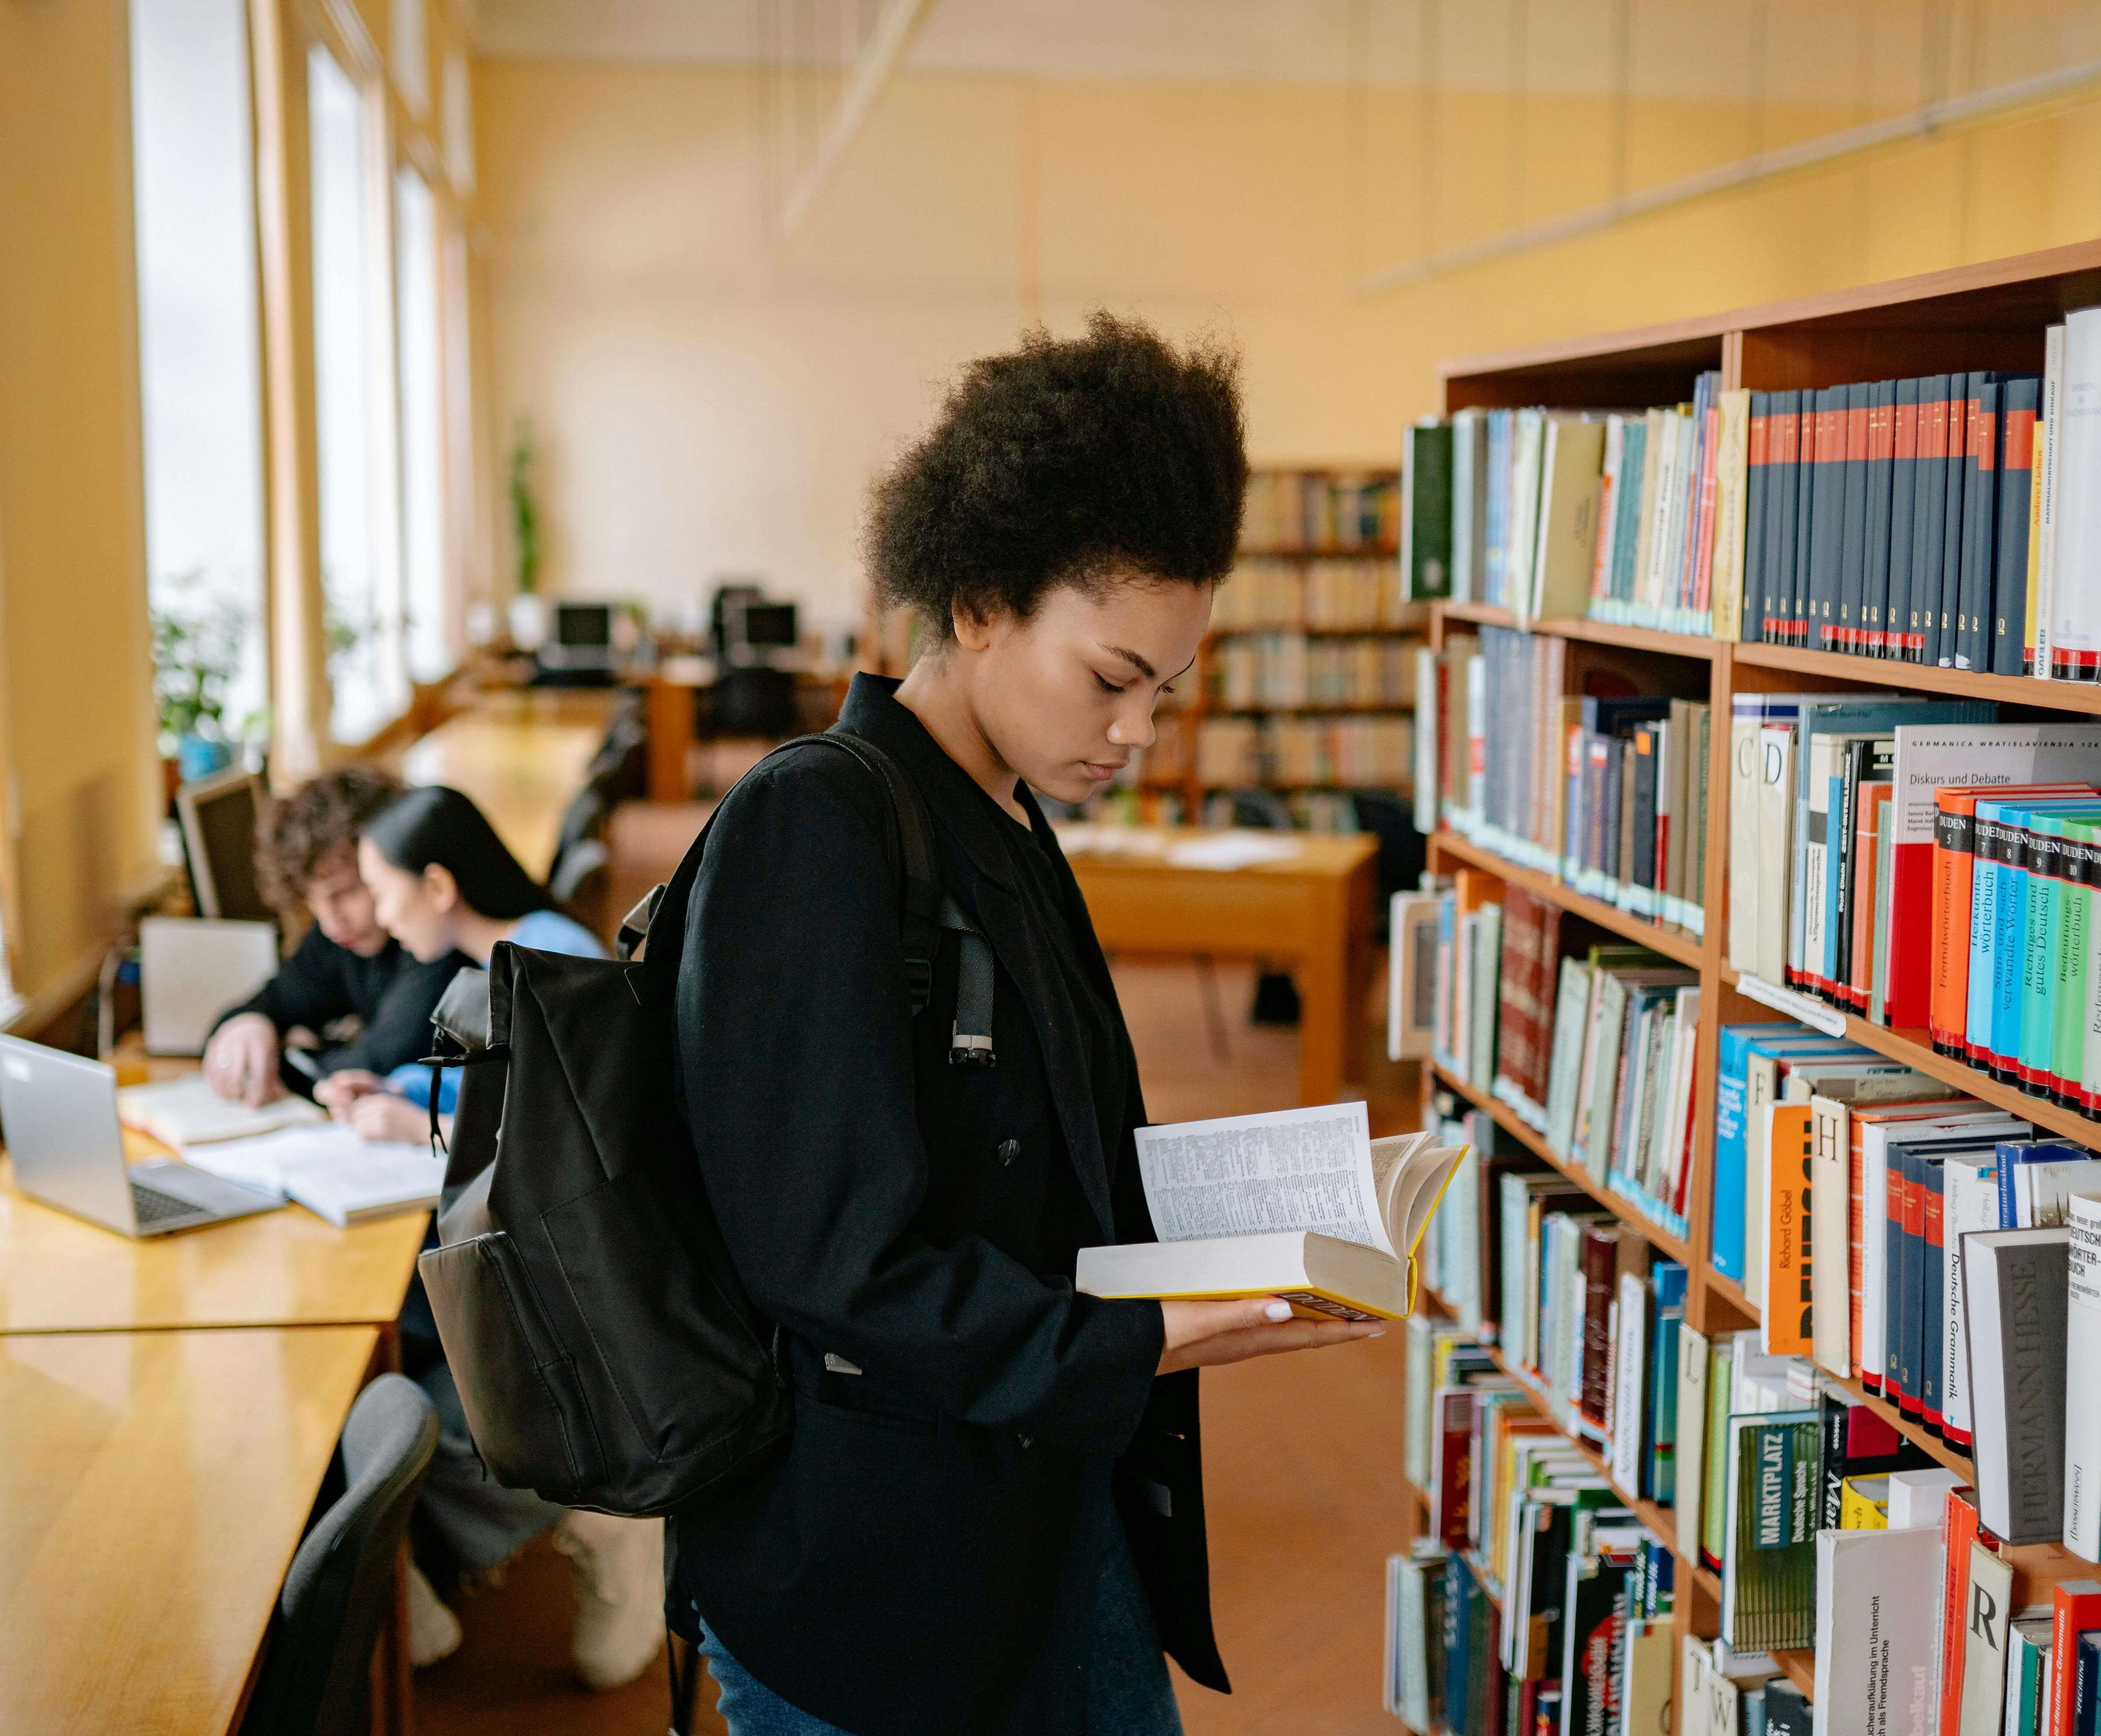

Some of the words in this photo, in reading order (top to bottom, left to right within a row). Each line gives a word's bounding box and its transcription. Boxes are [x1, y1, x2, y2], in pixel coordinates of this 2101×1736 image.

[1739, 738, 1754, 779] C
[1763, 742, 1782, 785] D
[1910, 774, 1945, 785] Diskurs
[1949, 774, 1968, 783] und
[1972, 774, 2011, 784] Debatte
[1940, 815, 1966, 830] DUDEN
[1946, 834, 1951, 845] 5
[1981, 842, 1986, 852] 7
[2006, 848, 2012, 859] 8
[2029, 838, 2060, 854] DUDEN
[2036, 858, 2042, 868] 9
[2062, 844, 2093, 861] DUDEN
[2070, 865, 2077, 876] 10
[1940, 861, 1952, 989] Fremdwörterbuch
[1972, 868, 1981, 947] Herkunfts-
[1980, 871, 1994, 953] wörterbuch
[2006, 880, 2019, 928] Wörter
[2037, 887, 2050, 952] Deutsch
[2025, 917, 2035, 987] Richtiges
[2060, 894, 2070, 983] Bedeutungs-
[2071, 897, 2082, 977] wörterbuch
[1995, 950, 2004, 990] Sinn-
[2004, 937, 2016, 1010] verwandte
[2036, 956, 2046, 996] gutes
[1816, 1112, 1840, 1163] H
[1780, 1189, 1793, 1224] Göbel
[2076, 1215, 2089, 1225] neue
[1780, 1226, 1792, 1269] Richard
[1950, 1253, 1960, 1317] Deutsche
[2011, 1262, 2041, 1352] HESSE
[1948, 1320, 1959, 1401] Grammatik
[2016, 1360, 2050, 1527] HERMANN
[1760, 1432, 1784, 1545] MARKTPLATZ
[1792, 1499, 1806, 1543] Deutsche
[1869, 1595, 1880, 1644] Unterricht
[1969, 1579, 1999, 1651] R
[1868, 1647, 1878, 1659] im
[2056, 1608, 2066, 1670] Grammatik
[1879, 1639, 1890, 1710] Fremdsprache
[1878, 1711, 1887, 1726] als
